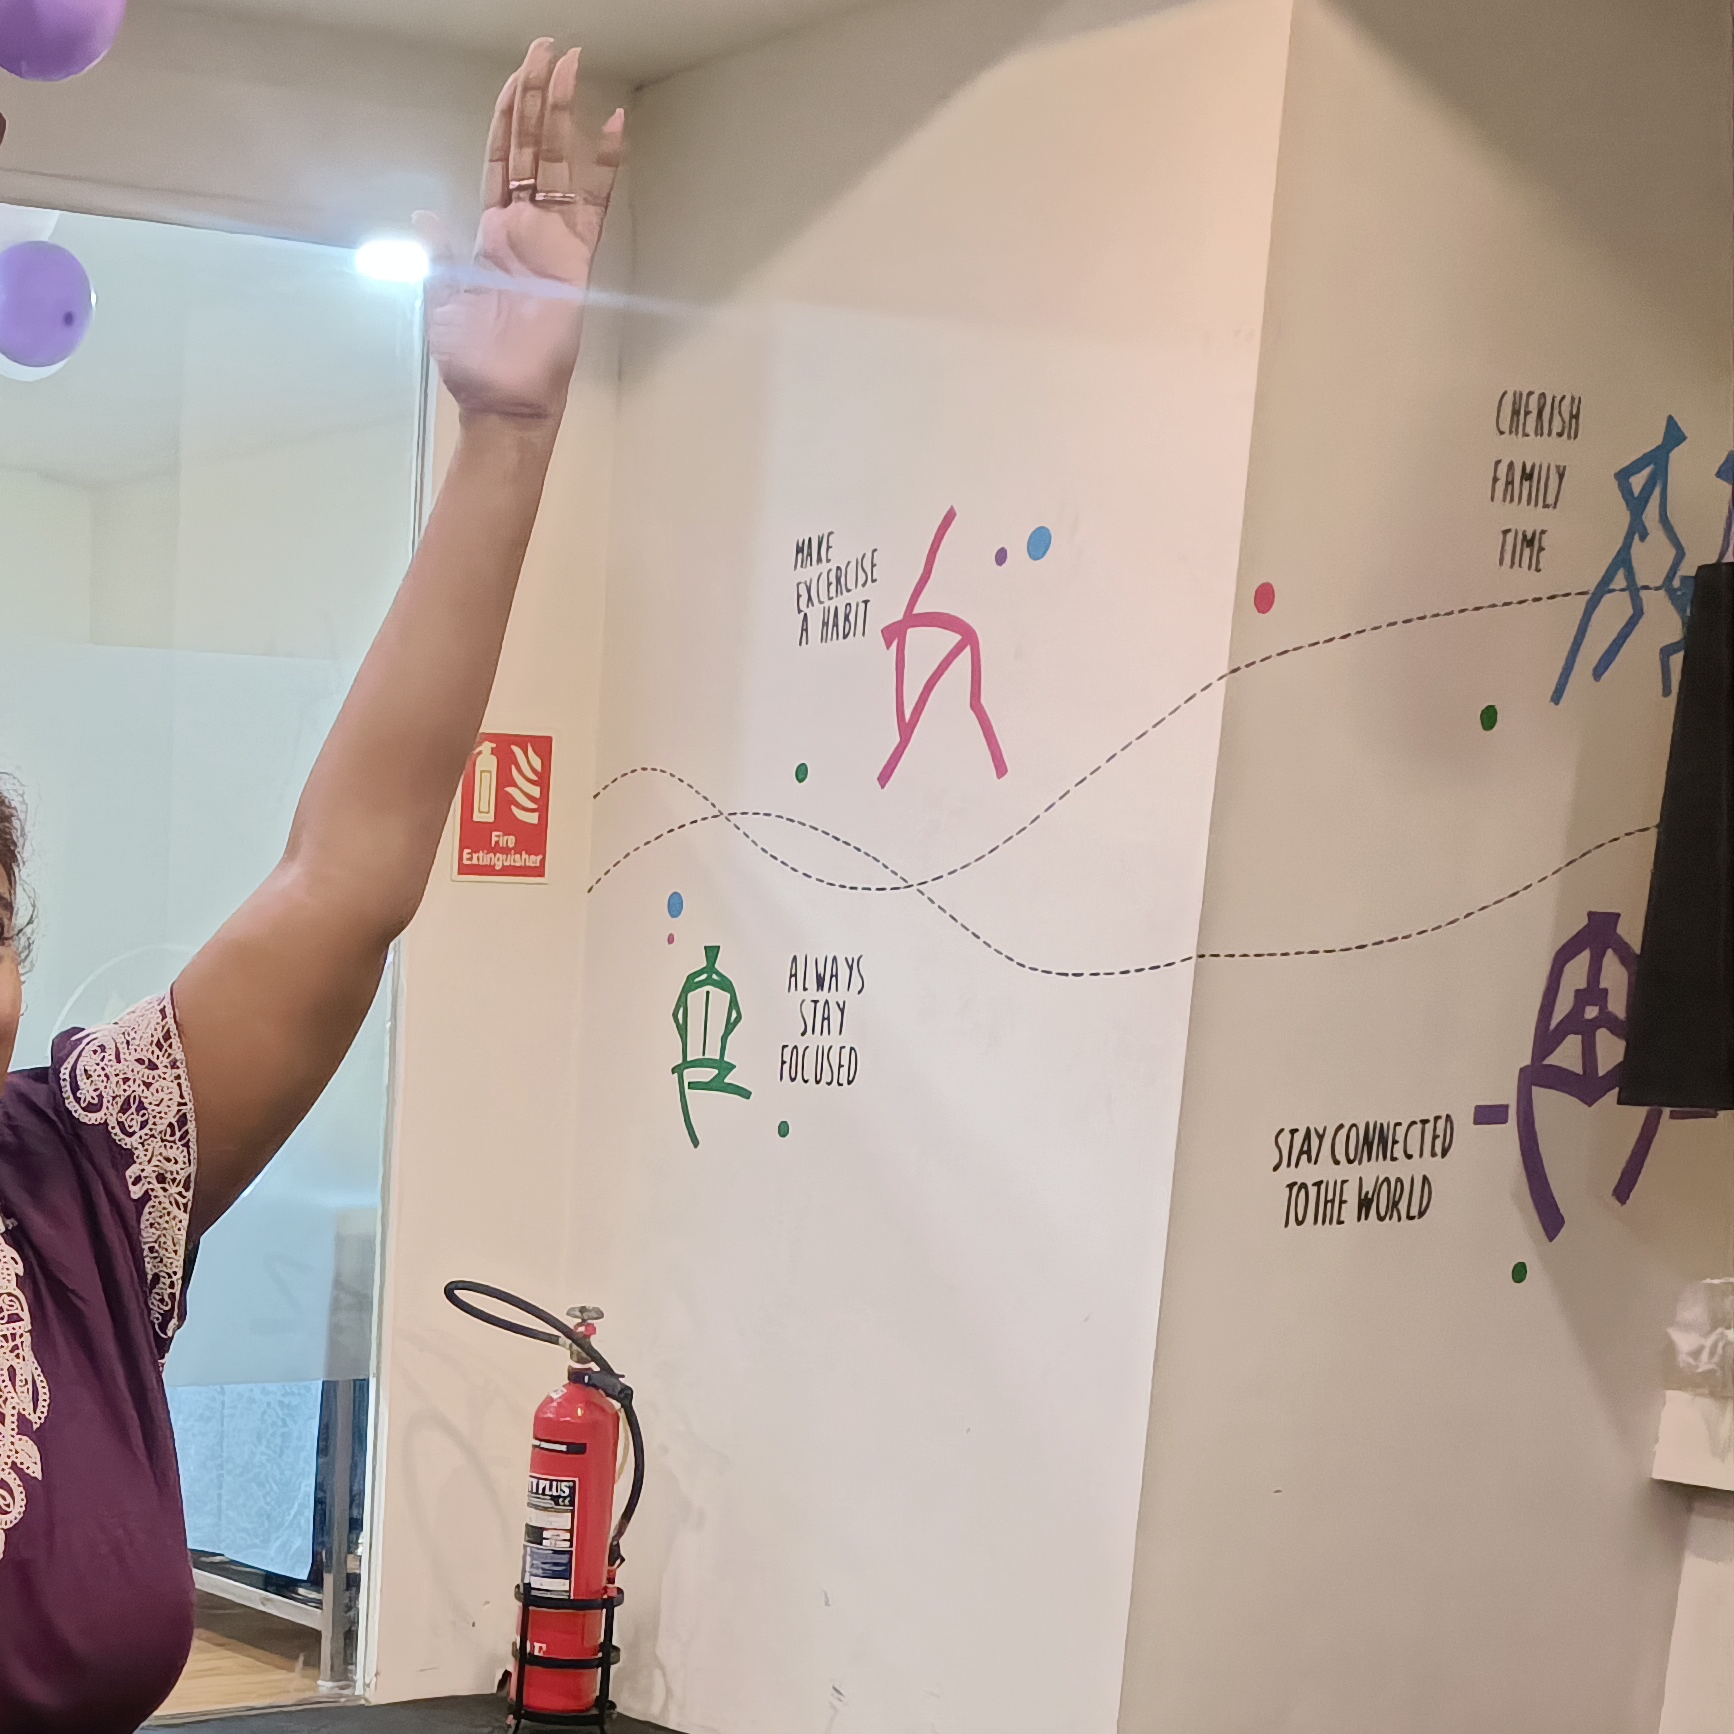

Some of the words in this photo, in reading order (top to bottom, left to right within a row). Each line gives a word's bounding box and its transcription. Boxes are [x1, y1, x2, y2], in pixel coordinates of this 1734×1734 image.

[1495, 389, 1581, 441] CHERISH
[1490, 458, 1567, 510] FAMILY
[793, 530, 834, 571] MAKE
[1498, 527, 1548, 573] TIME
[796, 548, 878, 614] EXCERCISE
[798, 612, 809, 647] A
[820, 599, 871, 643] HABIT
[462, 848, 543, 870] Extinguisher
[491, 831, 516, 848] Fire
[787, 953, 865, 995] ALWAYS
[799, 998, 846, 1037] STAY
[779, 1044, 858, 1086] FOCUSED
[1272, 1125, 1327, 1172] STAY
[1330, 1113, 1454, 1166] CONNECTED
[1356, 1174, 1433, 1223] WORLD
